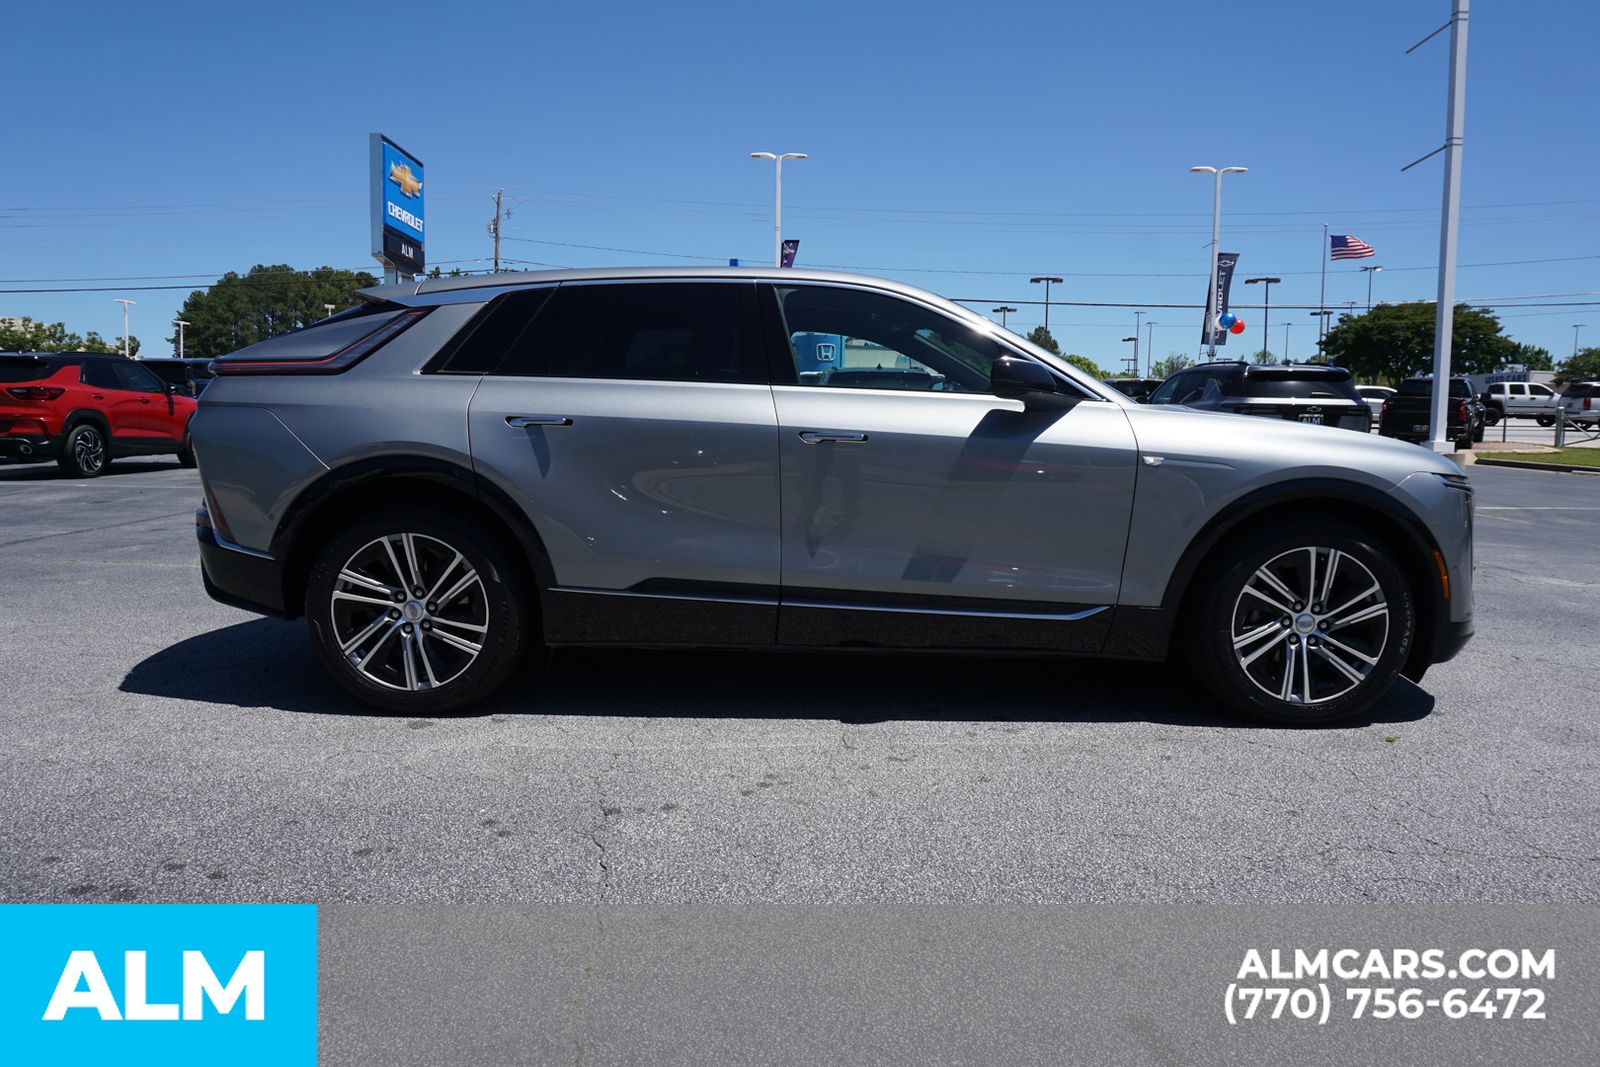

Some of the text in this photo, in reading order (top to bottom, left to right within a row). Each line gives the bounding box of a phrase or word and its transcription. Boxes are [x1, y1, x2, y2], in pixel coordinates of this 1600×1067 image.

[388, 201, 423, 231] CHEVROLET
[401, 244, 413, 259] ALM
[1214, 271, 1226, 339] CVROLET
